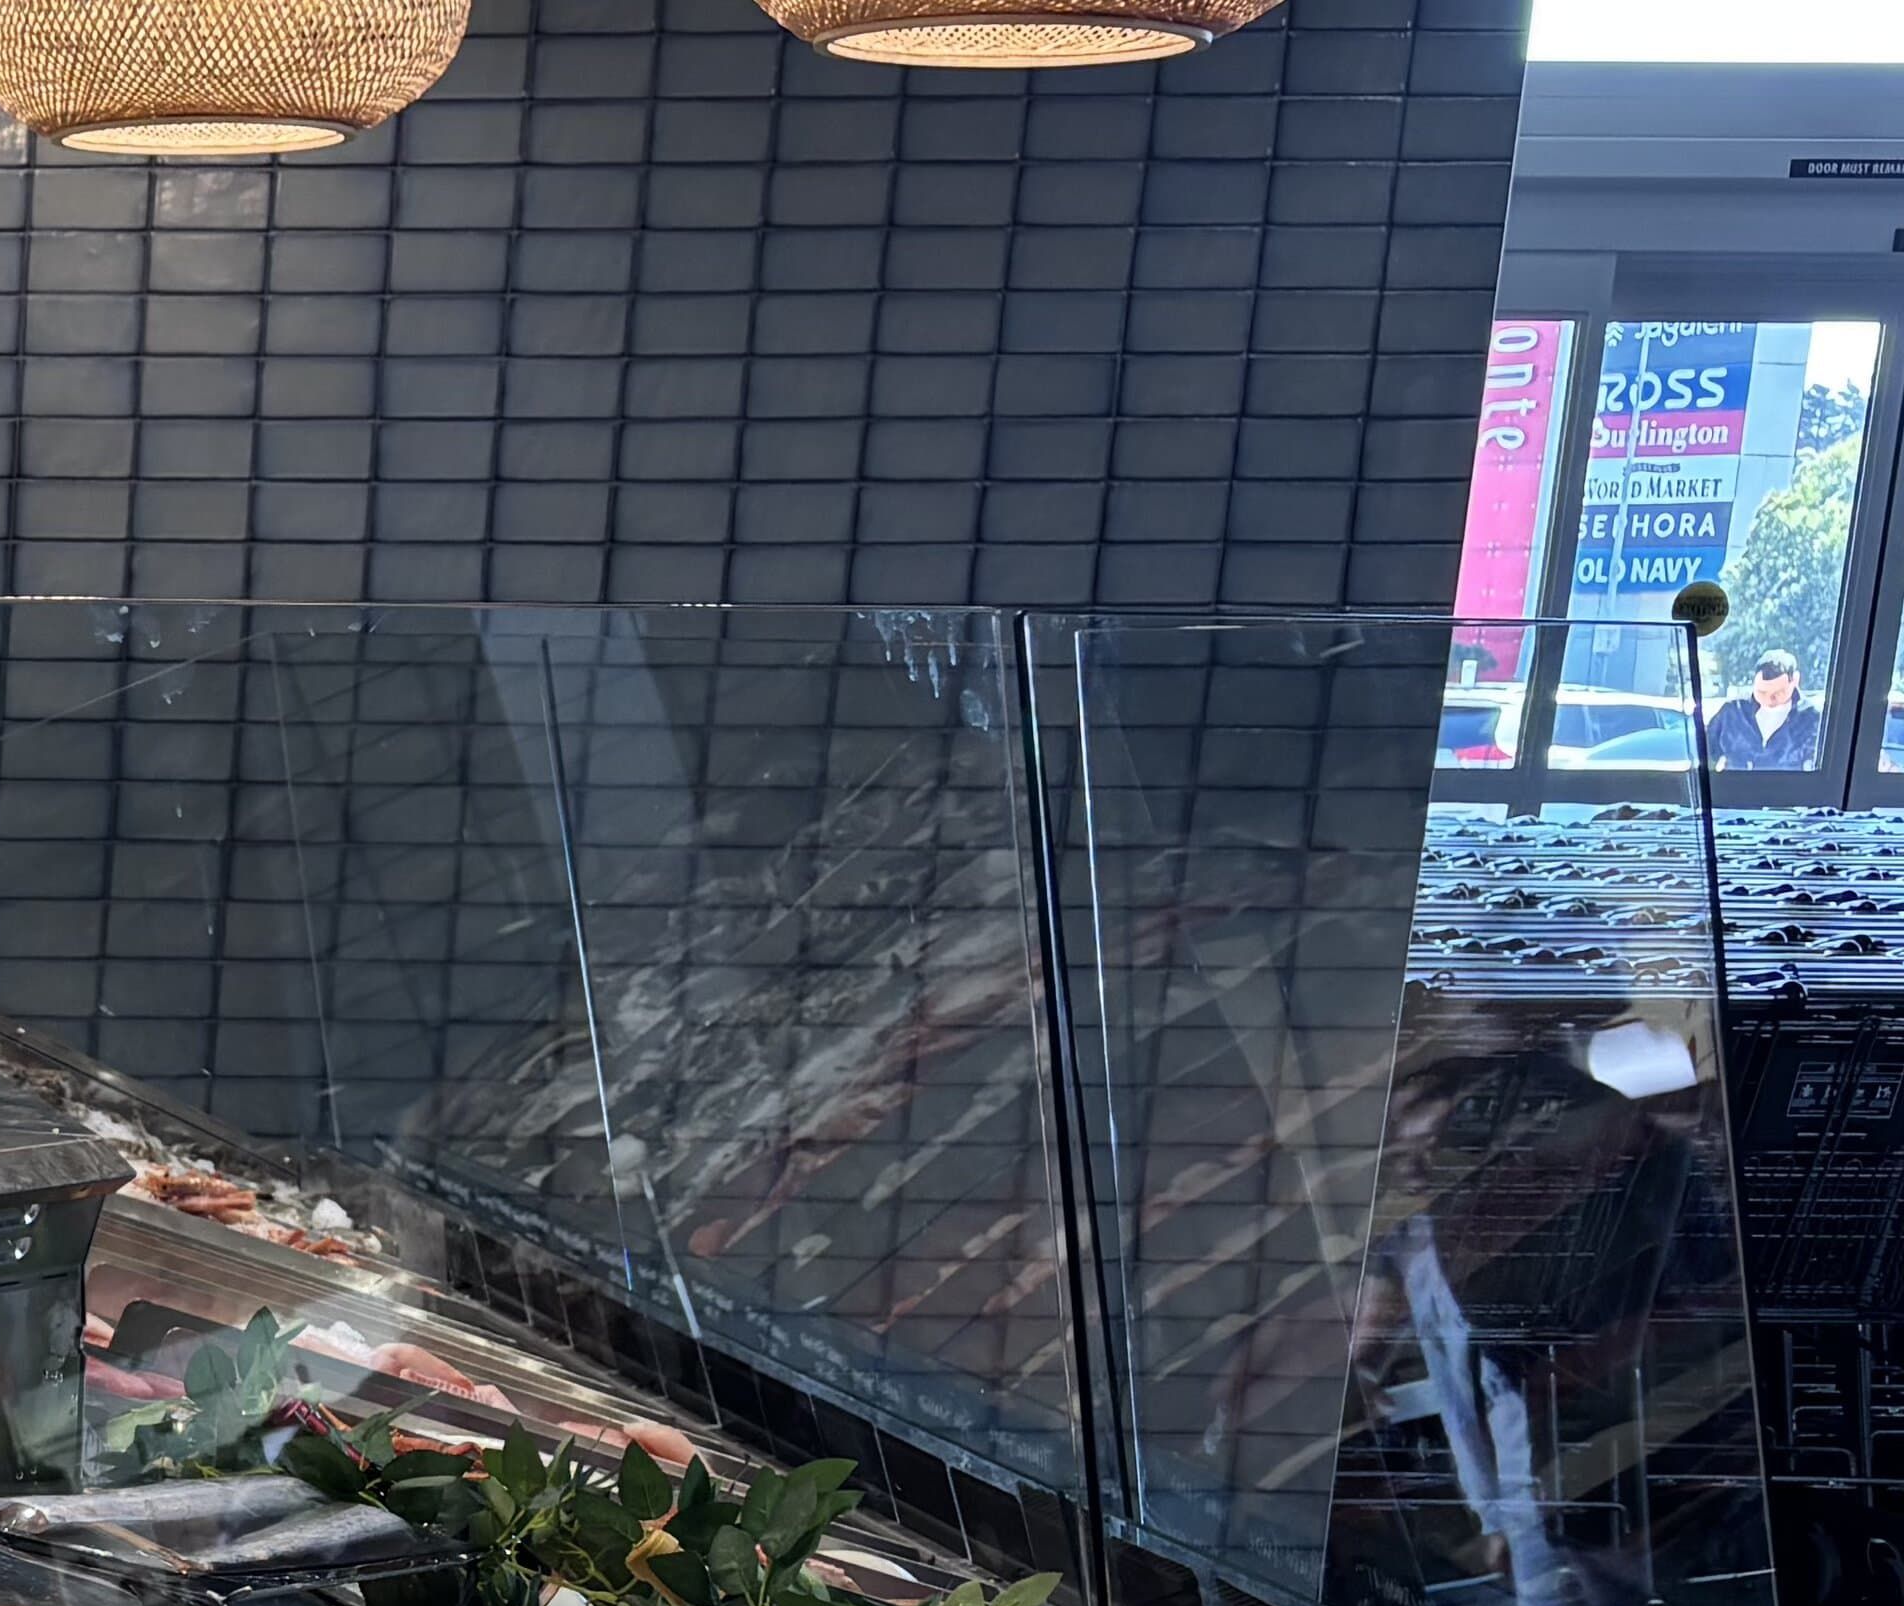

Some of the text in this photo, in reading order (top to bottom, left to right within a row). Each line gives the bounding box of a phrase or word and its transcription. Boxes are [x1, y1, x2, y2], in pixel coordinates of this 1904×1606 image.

[1807, 162, 1838, 175] DOOR
[1840, 162, 1871, 175] MUST
[1590, 416, 1730, 454] Bulington
[1646, 475, 1723, 499] MARKET
[1630, 556, 1703, 584] NAVY
